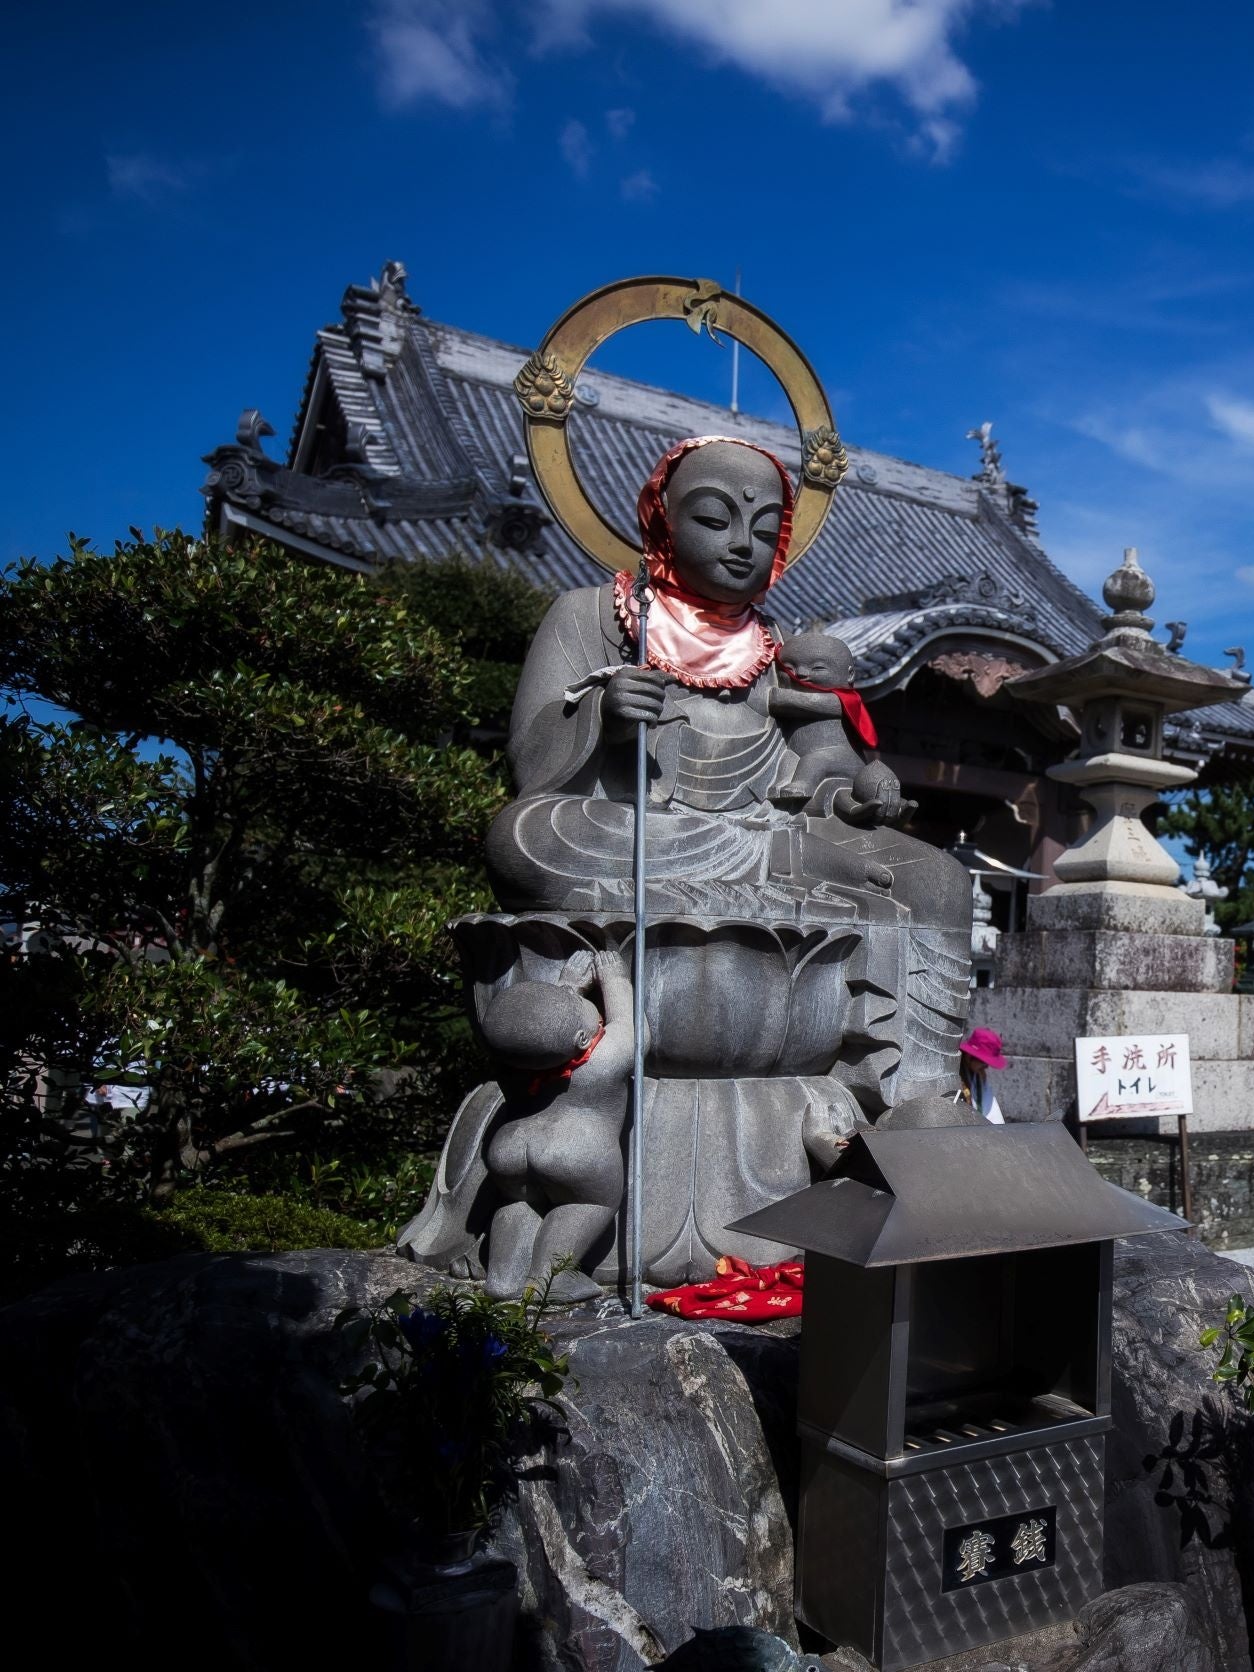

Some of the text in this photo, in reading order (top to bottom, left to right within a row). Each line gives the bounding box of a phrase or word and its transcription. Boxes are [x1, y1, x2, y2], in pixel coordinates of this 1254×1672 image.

[1090, 1042, 1178, 1075] 手洗所
[1117, 1076, 1157, 1096] トイレ
[956, 1518, 1048, 1582] 賽銭
